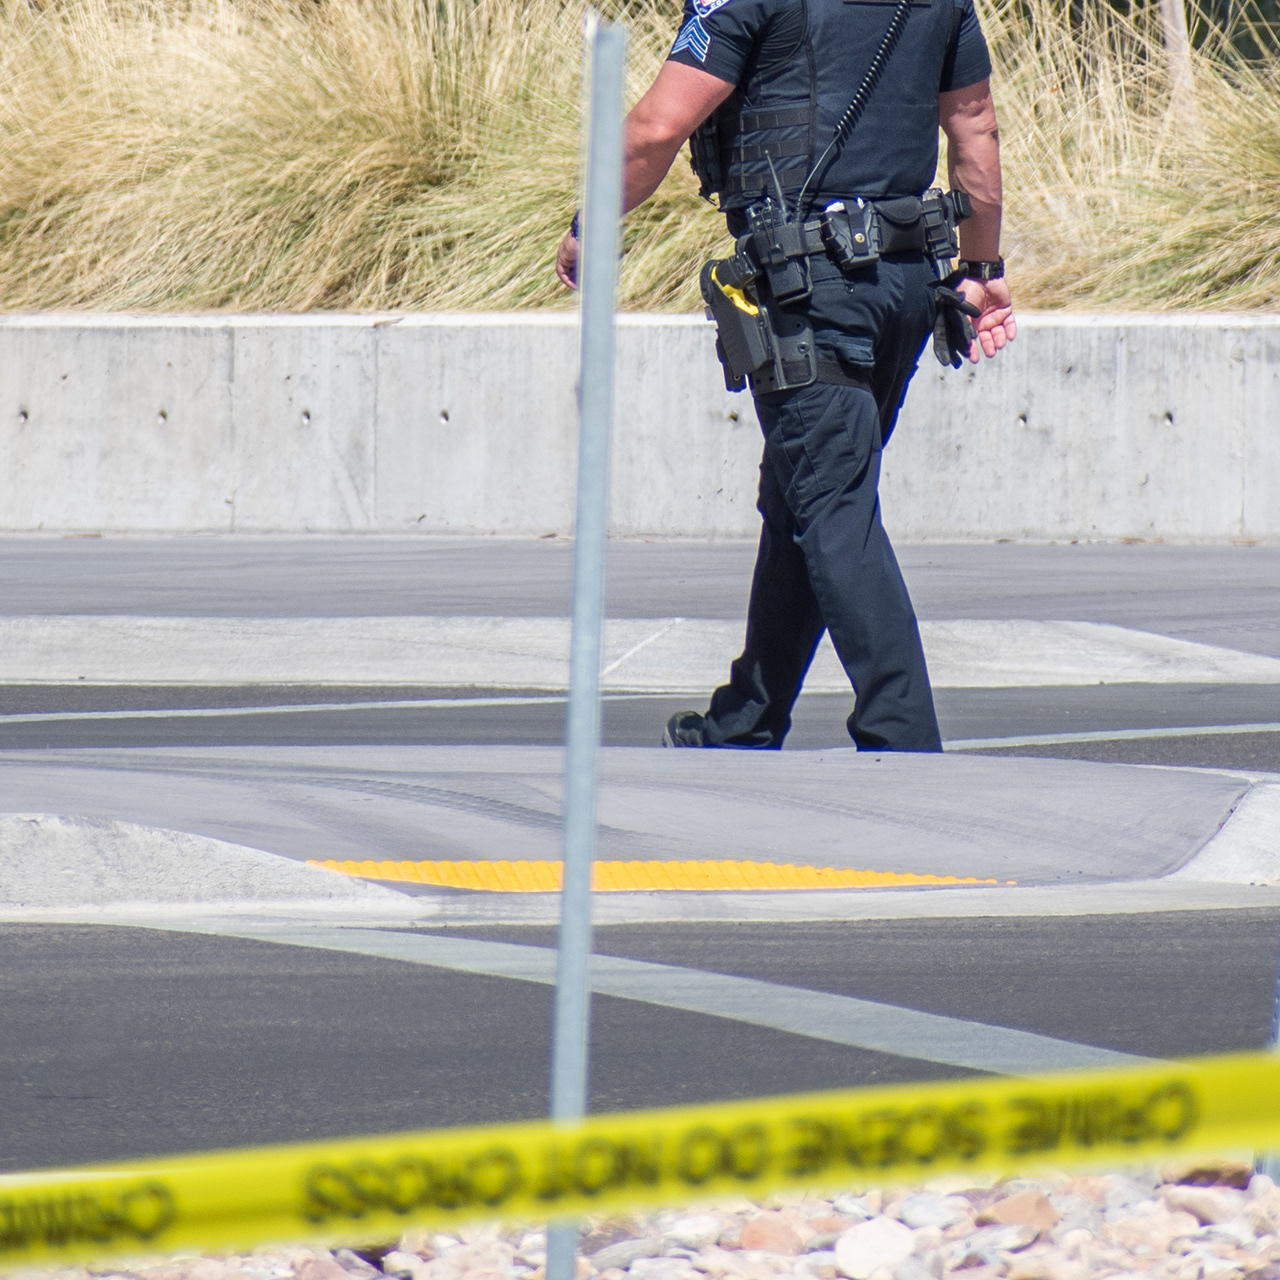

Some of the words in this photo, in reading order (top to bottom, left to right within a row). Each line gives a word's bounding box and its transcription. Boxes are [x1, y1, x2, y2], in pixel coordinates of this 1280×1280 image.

[677, 1122, 770, 1188] DO
[786, 1100, 989, 1178] SCENE
[1005, 1080, 1202, 1157] CRIME
